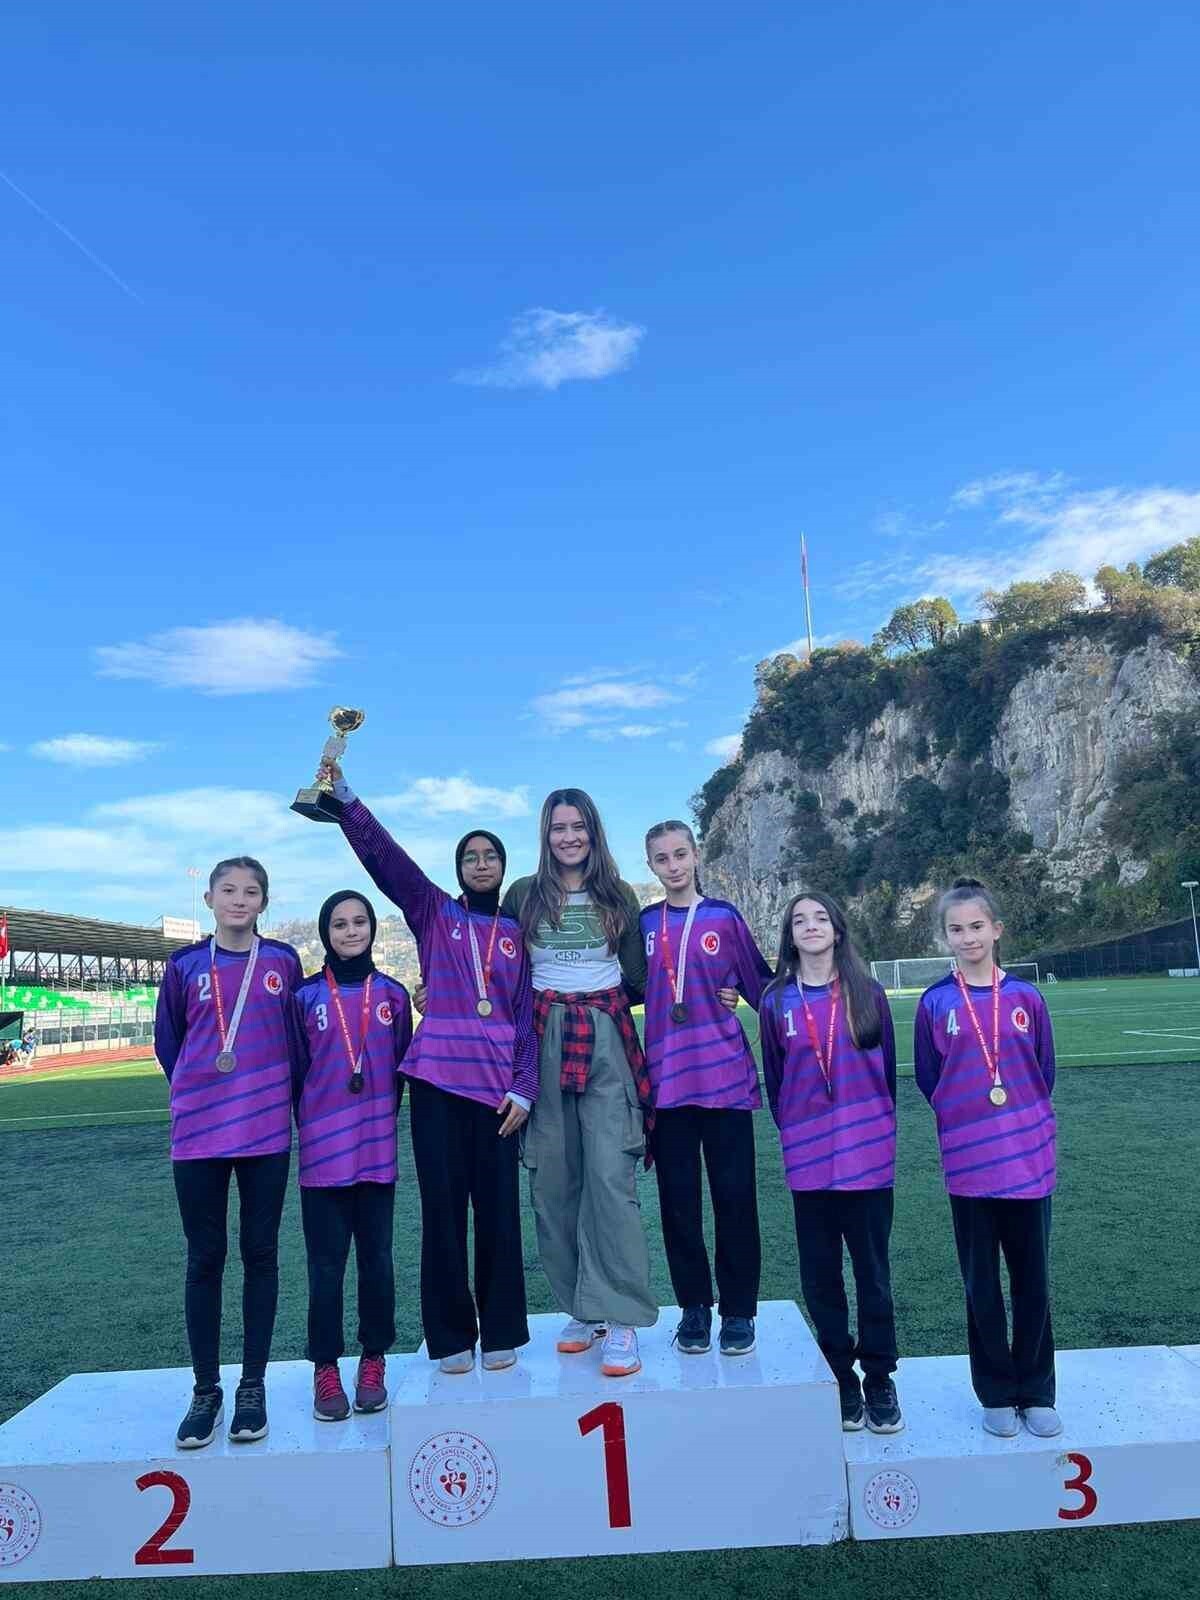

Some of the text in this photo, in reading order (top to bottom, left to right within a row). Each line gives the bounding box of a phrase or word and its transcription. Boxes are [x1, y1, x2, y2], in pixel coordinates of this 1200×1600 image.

[645, 931, 656, 957] 6
[198, 973, 212, 1002] 2
[315, 1003, 328, 1032] 3
[784, 1009, 798, 1037] 1
[946, 1008, 960, 1036] 4
[578, 1402, 631, 1528] 1
[1057, 1453, 1098, 1519] 3
[135, 1471, 194, 1564] 2
